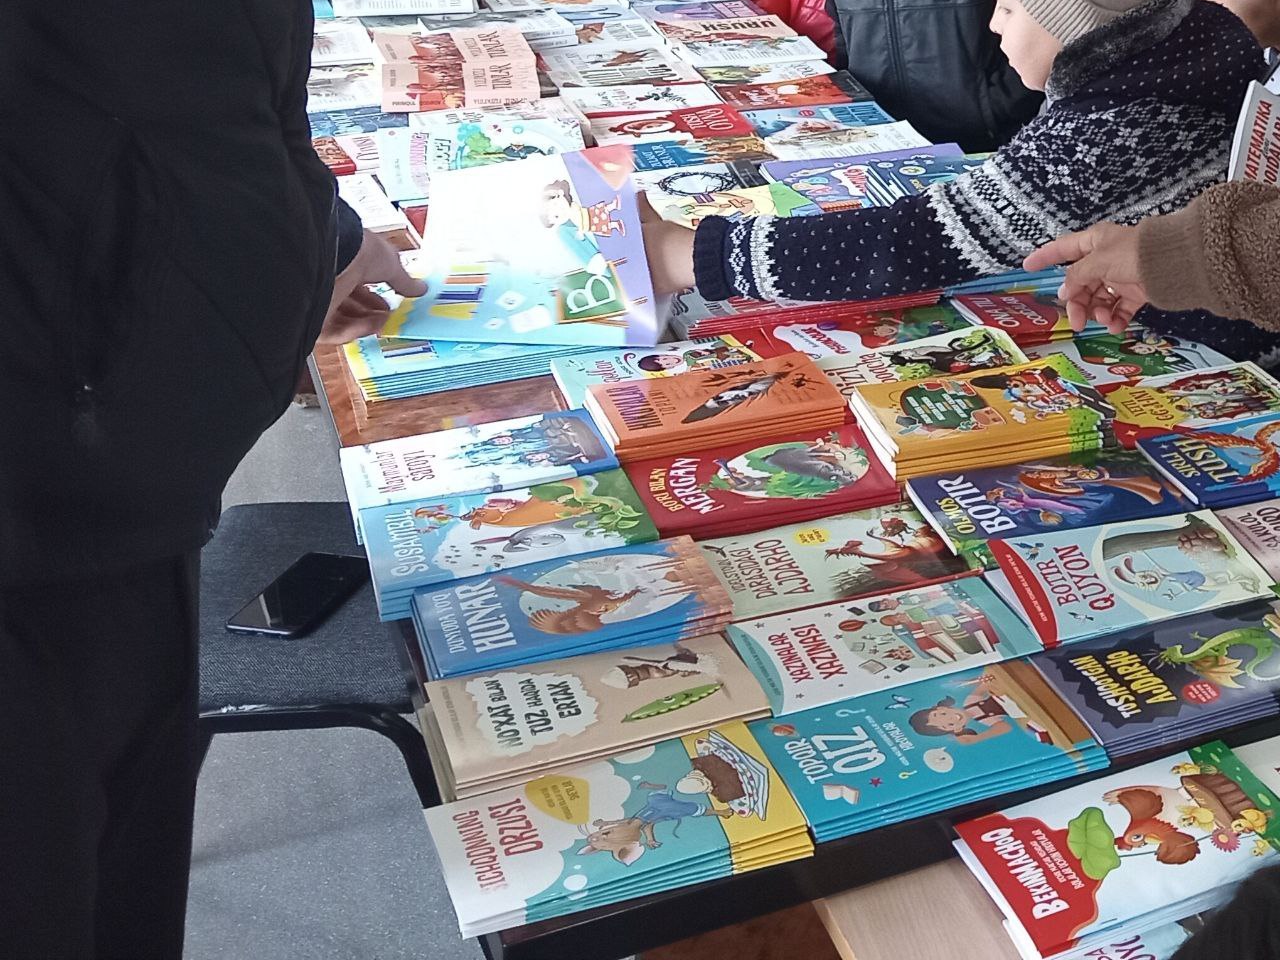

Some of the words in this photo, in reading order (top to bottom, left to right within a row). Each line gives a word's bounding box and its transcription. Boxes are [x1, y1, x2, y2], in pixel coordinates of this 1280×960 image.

[1243, 100, 1273, 181] MATEMATIKA
[668, 457, 726, 515] MERGAN
[1160, 451, 1201, 480] SIRLI
[1174, 437, 1243, 483] TUSH
[937, 498, 977, 535] OLMOS
[938, 475, 1018, 535] BOTIR
[1237, 512, 1271, 538] KULOL
[385, 507, 429, 578] SUSAMBIL
[754, 538, 815, 596] AJDARHO
[730, 546, 779, 600] DARASIDAGI
[1035, 558, 1081, 607] BOTIR
[1053, 543, 1116, 611] QUYON
[438, 613, 468, 654] DUNYODA
[454, 578, 518, 654] HUNAR
[767, 631, 815, 684] XAZINALAR
[790, 622, 848, 680] XAZINASI
[1105, 650, 1178, 705] AJDARHO
[484, 678, 509, 705] BILAN
[546, 680, 583, 719] ERTAK
[525, 708, 555, 737] TUZ
[811, 724, 886, 775] QIZ
[783, 737, 834, 785] TOPQIR
[450, 809, 511, 893] ICHQONNING
[488, 797, 544, 858] ORZUSI
[980, 826, 1070, 920] BEKINMACHOQ
